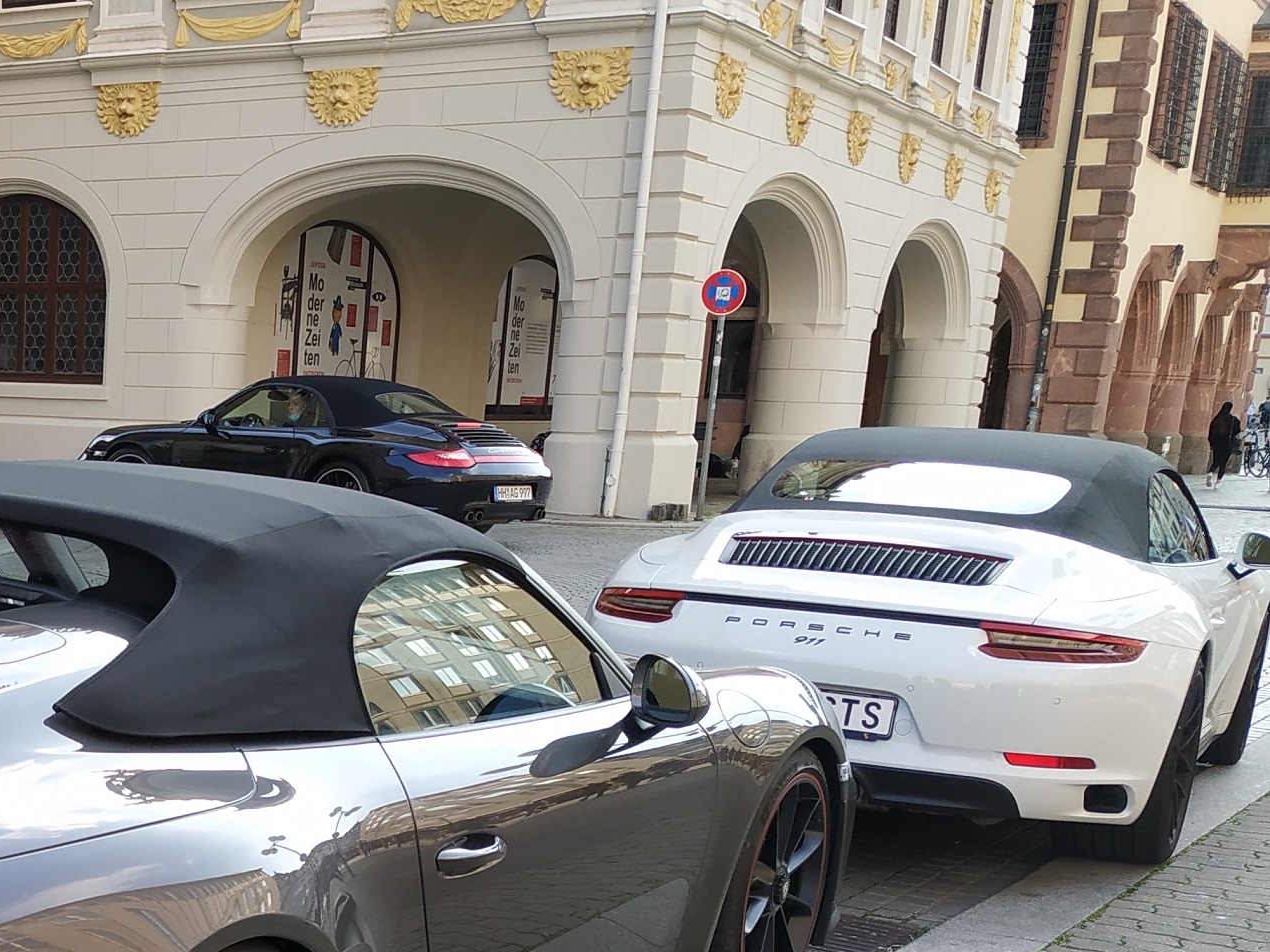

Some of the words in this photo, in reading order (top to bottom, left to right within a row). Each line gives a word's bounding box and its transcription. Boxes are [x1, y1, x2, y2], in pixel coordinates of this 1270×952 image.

[309, 273, 325, 292] Mo
[307, 293, 325, 312] der
[513, 296, 525, 311] Mo
[306, 313, 320, 327] ne
[512, 313, 525, 328] der
[305, 329, 321, 347] Zei
[510, 329, 520, 341] ne
[304, 350, 320, 366] ten
[509, 343, 521, 358] Zei
[507, 360, 519, 374] ten
[497, 487, 506, 497] HH
[510, 487, 518, 498] AG
[519, 487, 530, 498] 997
[724, 615, 912, 642] PORSCHE
[793, 636, 826, 646] 911
[826, 696, 882, 730] TS
